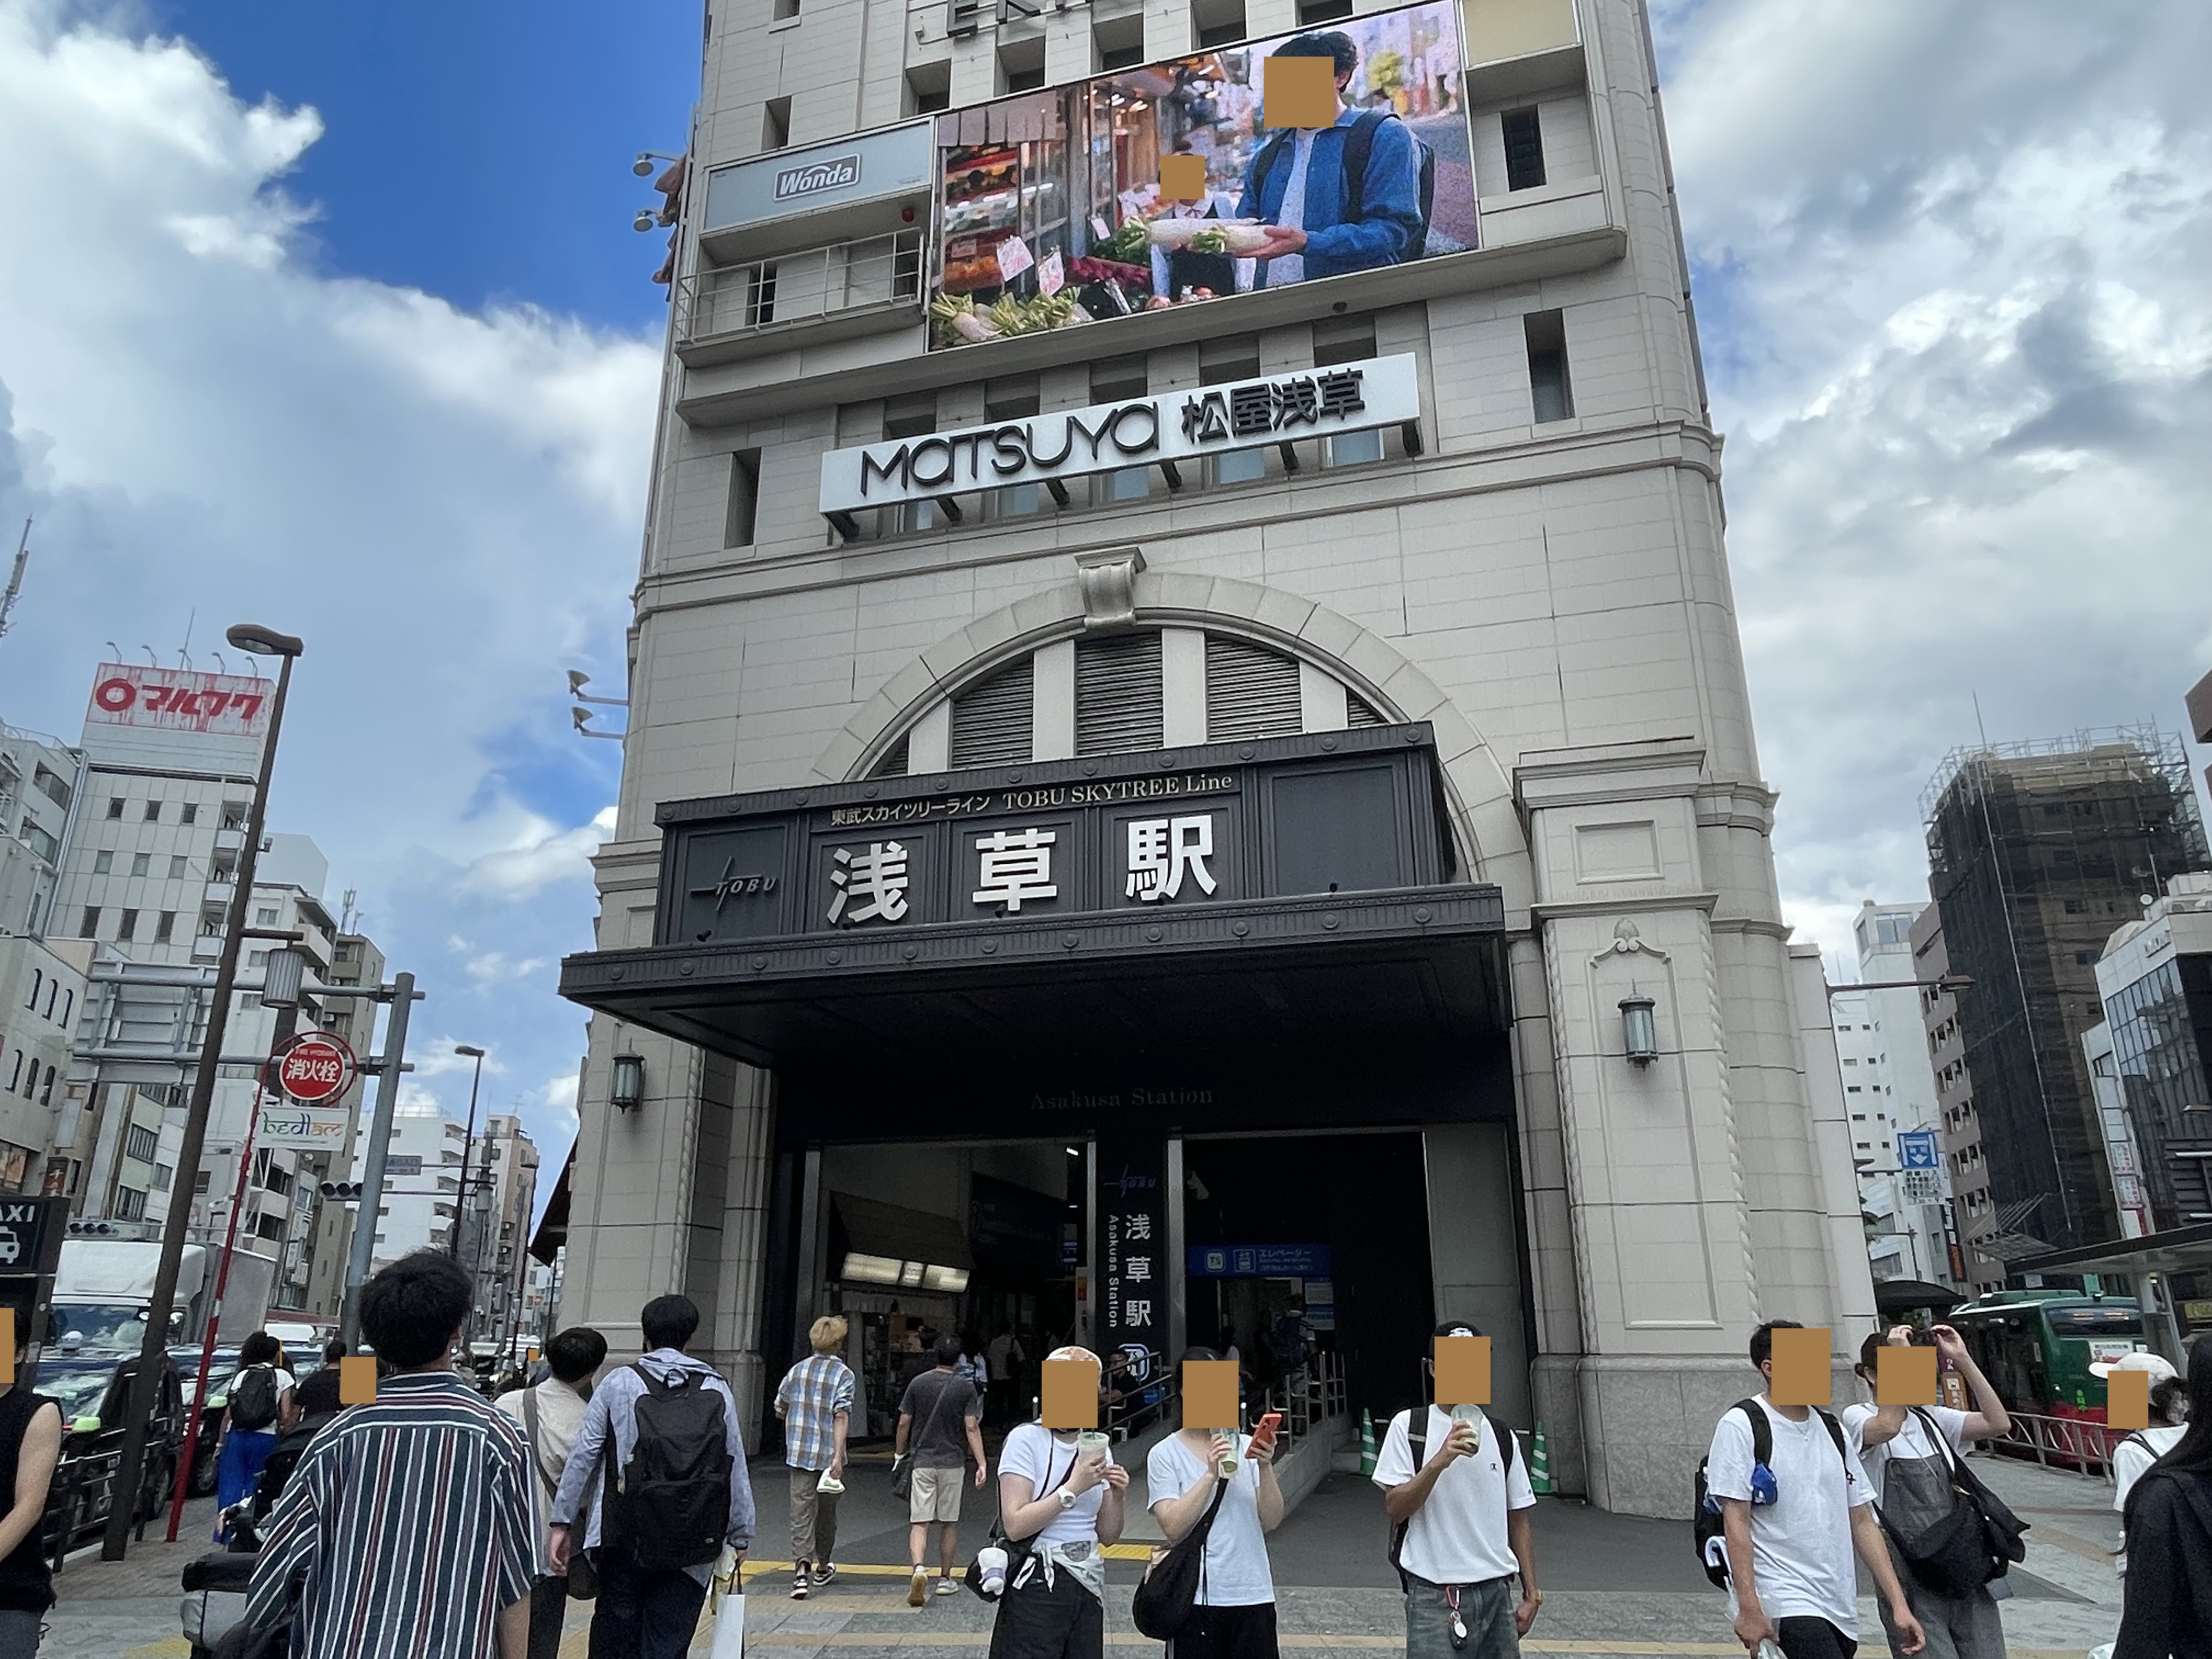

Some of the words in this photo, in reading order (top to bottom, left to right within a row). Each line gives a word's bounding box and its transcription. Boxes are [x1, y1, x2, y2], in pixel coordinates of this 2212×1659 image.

[780, 163, 854, 195] Wonda
[1181, 368, 1365, 444] 松屋浅草
[1002, 788, 1066, 810] TOBU
[1071, 777, 1180, 804] SKYTREE
[1186, 774, 1233, 793] Line
[831, 797, 990, 826] 東武スカイツリーライン
[826, 814, 1217, 924] 浅草駅
[285, 1058, 340, 1082] 消火栓
[1031, 1091, 1121, 1111] Asakusa
[1131, 1086, 1214, 1107] Station
[0, 1205, 35, 1222] XI
[1108, 1215, 1119, 1272] Asakusa
[1125, 1214, 1152, 1327] 浅草駅
[1108, 1277, 1119, 1327] Station
